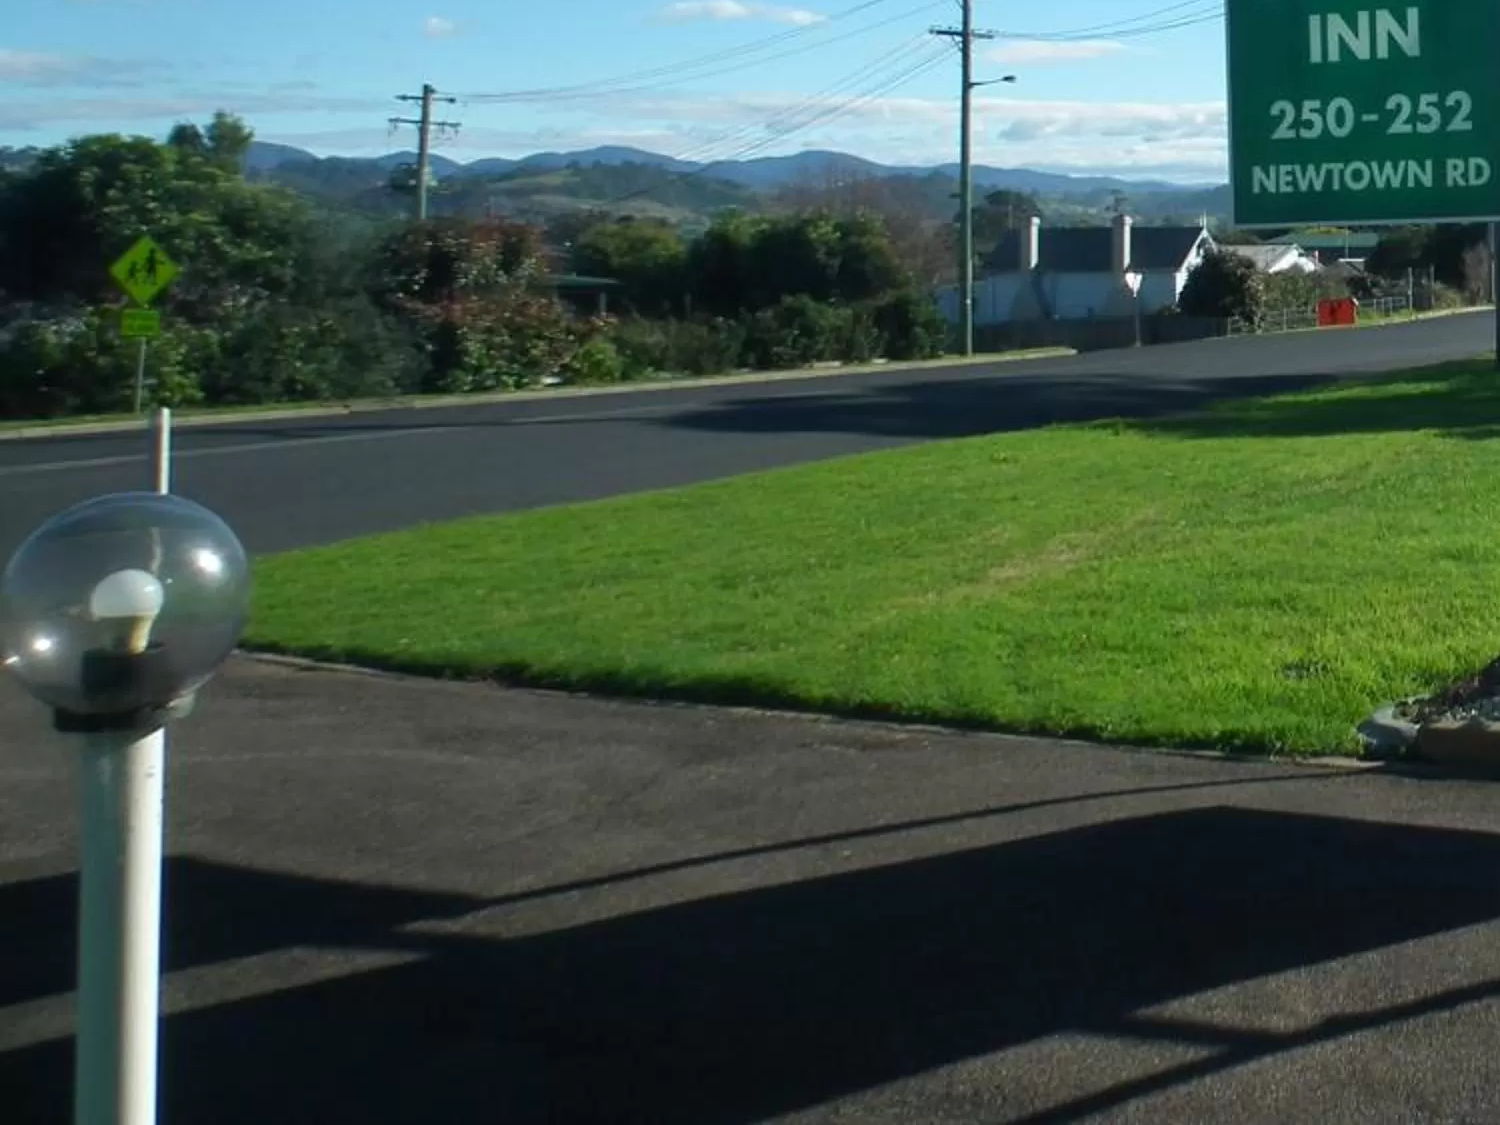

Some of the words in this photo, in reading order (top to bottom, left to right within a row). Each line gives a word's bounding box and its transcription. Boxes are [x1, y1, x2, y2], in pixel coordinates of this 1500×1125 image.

[1308, 7, 1420, 63] INN
[1252, 158, 1433, 193] NEWTOWN
[1446, 157, 1491, 186] RD
